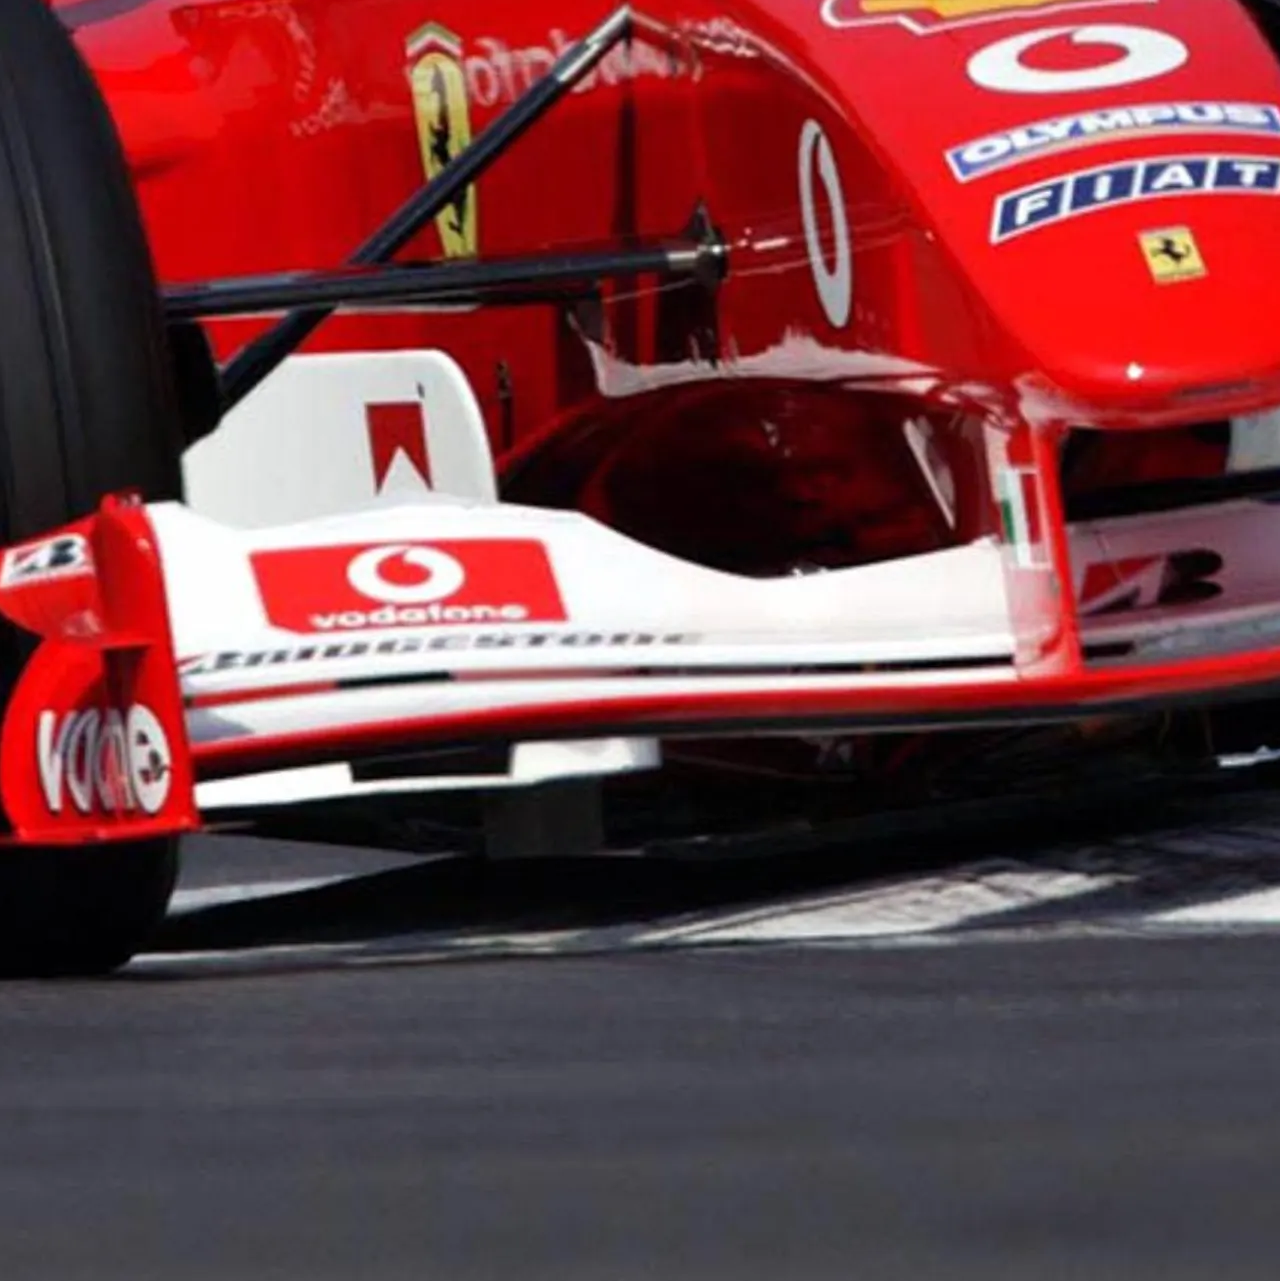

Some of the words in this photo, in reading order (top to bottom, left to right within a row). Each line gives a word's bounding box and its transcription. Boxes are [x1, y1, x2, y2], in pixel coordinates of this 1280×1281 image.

[960, 104, 1271, 164] OLYMPUS
[1014, 162, 1269, 226] FIAT
[308, 602, 531, 630] vodafone
